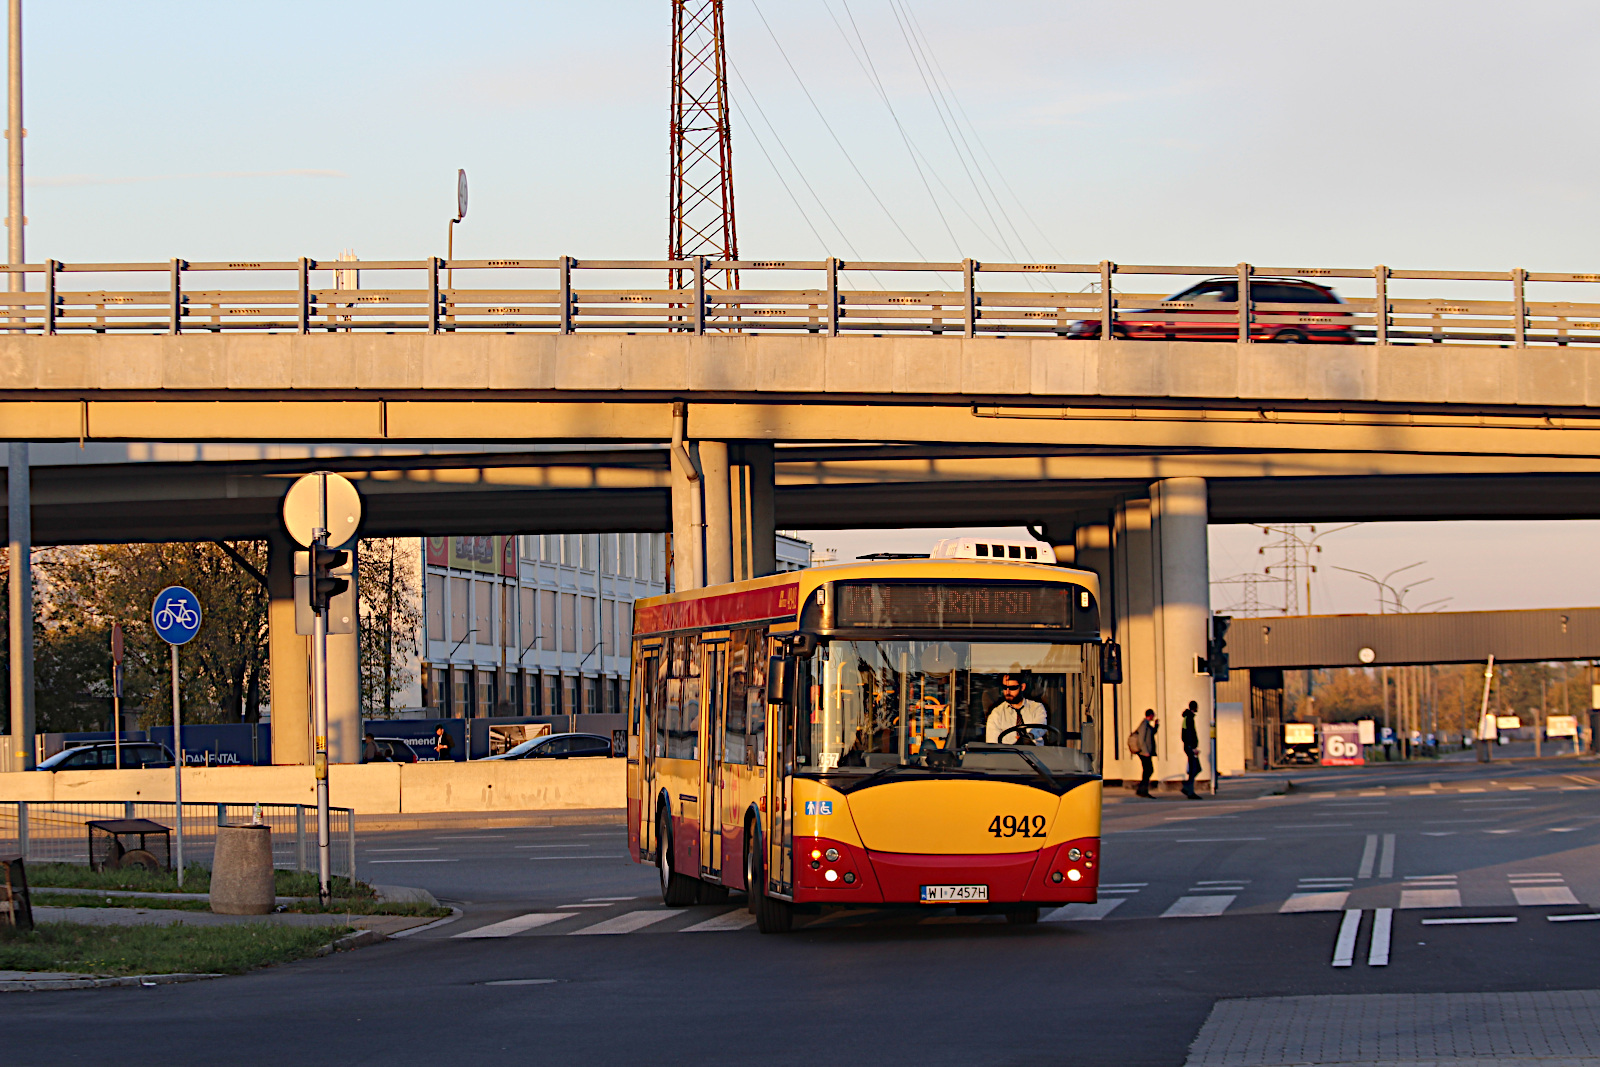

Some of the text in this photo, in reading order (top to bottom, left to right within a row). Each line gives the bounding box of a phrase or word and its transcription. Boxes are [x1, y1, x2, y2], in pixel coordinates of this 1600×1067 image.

[845, 586, 1031, 615] 734 ŻERAŃ FSO
[1328, 735, 1358, 757] 6D
[988, 815, 1047, 838] 4942
[928, 887, 943, 899] WI
[949, 887, 986, 898] 7457H
